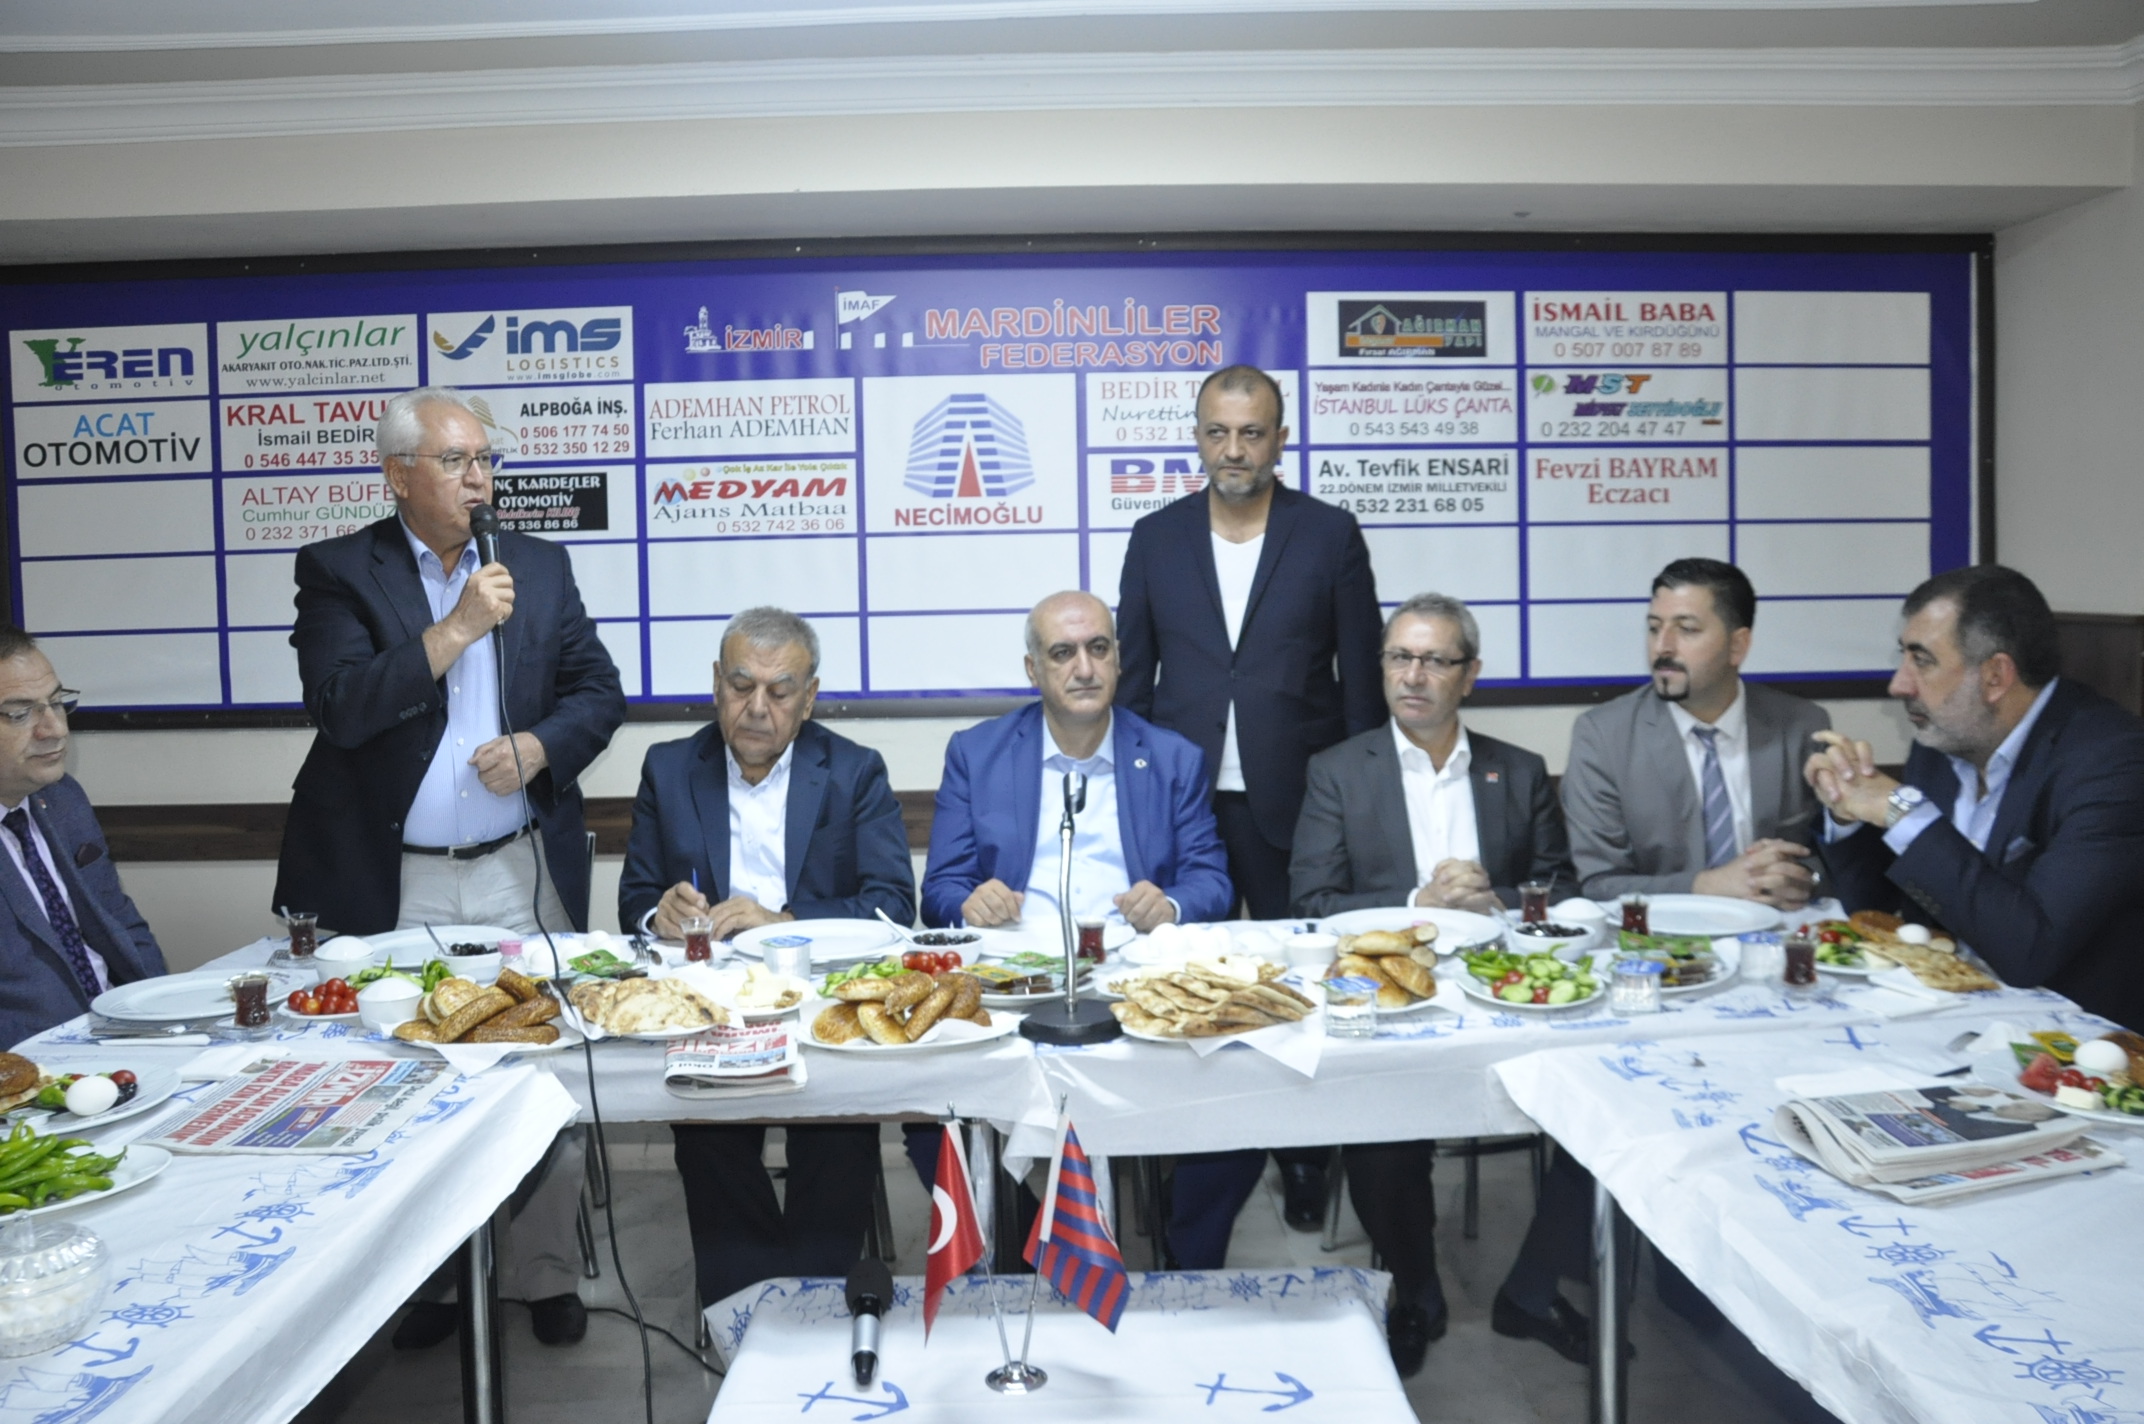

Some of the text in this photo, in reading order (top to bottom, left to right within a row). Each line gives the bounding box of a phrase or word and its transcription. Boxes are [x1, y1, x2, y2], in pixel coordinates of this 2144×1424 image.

[843, 298, 880, 311] İMAF
[1533, 297, 1716, 322] İSMAİL BABA
[925, 297, 1221, 339] MARDİNLİLER
[236, 320, 406, 360] yalçınlar
[725, 323, 803, 349] İZMİR
[1535, 326, 1600, 338] MANGAL
[1604, 326, 1624, 337] VE
[980, 340, 1223, 369] FEDERASYON
[1555, 343, 1566, 357] 0
[1572, 343, 1604, 357] 507
[1612, 343, 1645, 357] 007
[1652, 342, 1674, 357] 87
[221, 361, 276, 373] AKARYAKIT
[507, 356, 619, 371] LOGISTICS
[55, 379, 193, 391] otomotiv
[245, 372, 385, 389] www.yalcinlar.net
[1101, 377, 1178, 400] BEDİR
[1563, 373, 1652, 395] MST
[227, 400, 388, 426] KRAL TAVU
[520, 397, 628, 418] ALPBOĞA İNŞ.
[649, 394, 850, 420] ADEMHAN PETROL
[1313, 394, 1513, 419] İSTANBUL LÜKS ÇANTA
[73, 412, 155, 438] ACAT
[258, 425, 375, 446] İsmail BEDİR
[520, 423, 630, 438] 0 506 177 74 50
[651, 417, 849, 441] Ferhan ADEMHAN
[1117, 426, 1197, 441] 0 532 13
[1350, 421, 1480, 436] 0 543 543 49 38
[1541, 422, 1552, 438] 0
[1558, 421, 1592, 437] 232
[1598, 421, 1630, 437] 204
[1636, 421, 1658, 436] 47
[1664, 421, 1686, 436] 47
[23, 432, 200, 467] OTOMOTİV
[521, 440, 630, 455] 0 532 350 12 29
[245, 450, 380, 469] 0 546 447 35 35
[1318, 453, 1509, 478] Av. Tevfik ENSARİ
[1535, 457, 1718, 479] Fevzi BAYRAM
[518, 476, 600, 491] KARDEŞLER
[654, 477, 847, 505] MEDYAM
[1319, 482, 1383, 494] 22.DÖNEM
[1387, 482, 1422, 493] İZMİR
[1588, 483, 1670, 504] Eczacı
[241, 485, 320, 506] ALTAY
[499, 492, 573, 508] OTOMOTİV
[1112, 497, 1176, 510] Güvenli
[1356, 499, 1390, 513] 532
[1395, 498, 1429, 513] 231
[1434, 498, 1457, 512] 68
[1461, 498, 1484, 512] 05
[242, 502, 397, 523] Cumhur GÜNDÜZ
[653, 501, 847, 523] Ajans Matbaa
[895, 502, 1043, 526] NECİMOĞLU
[245, 527, 256, 541] 0
[261, 526, 293, 540] 232
[299, 525, 329, 539] 371
[717, 518, 845, 533] 0 532 742 36 06
